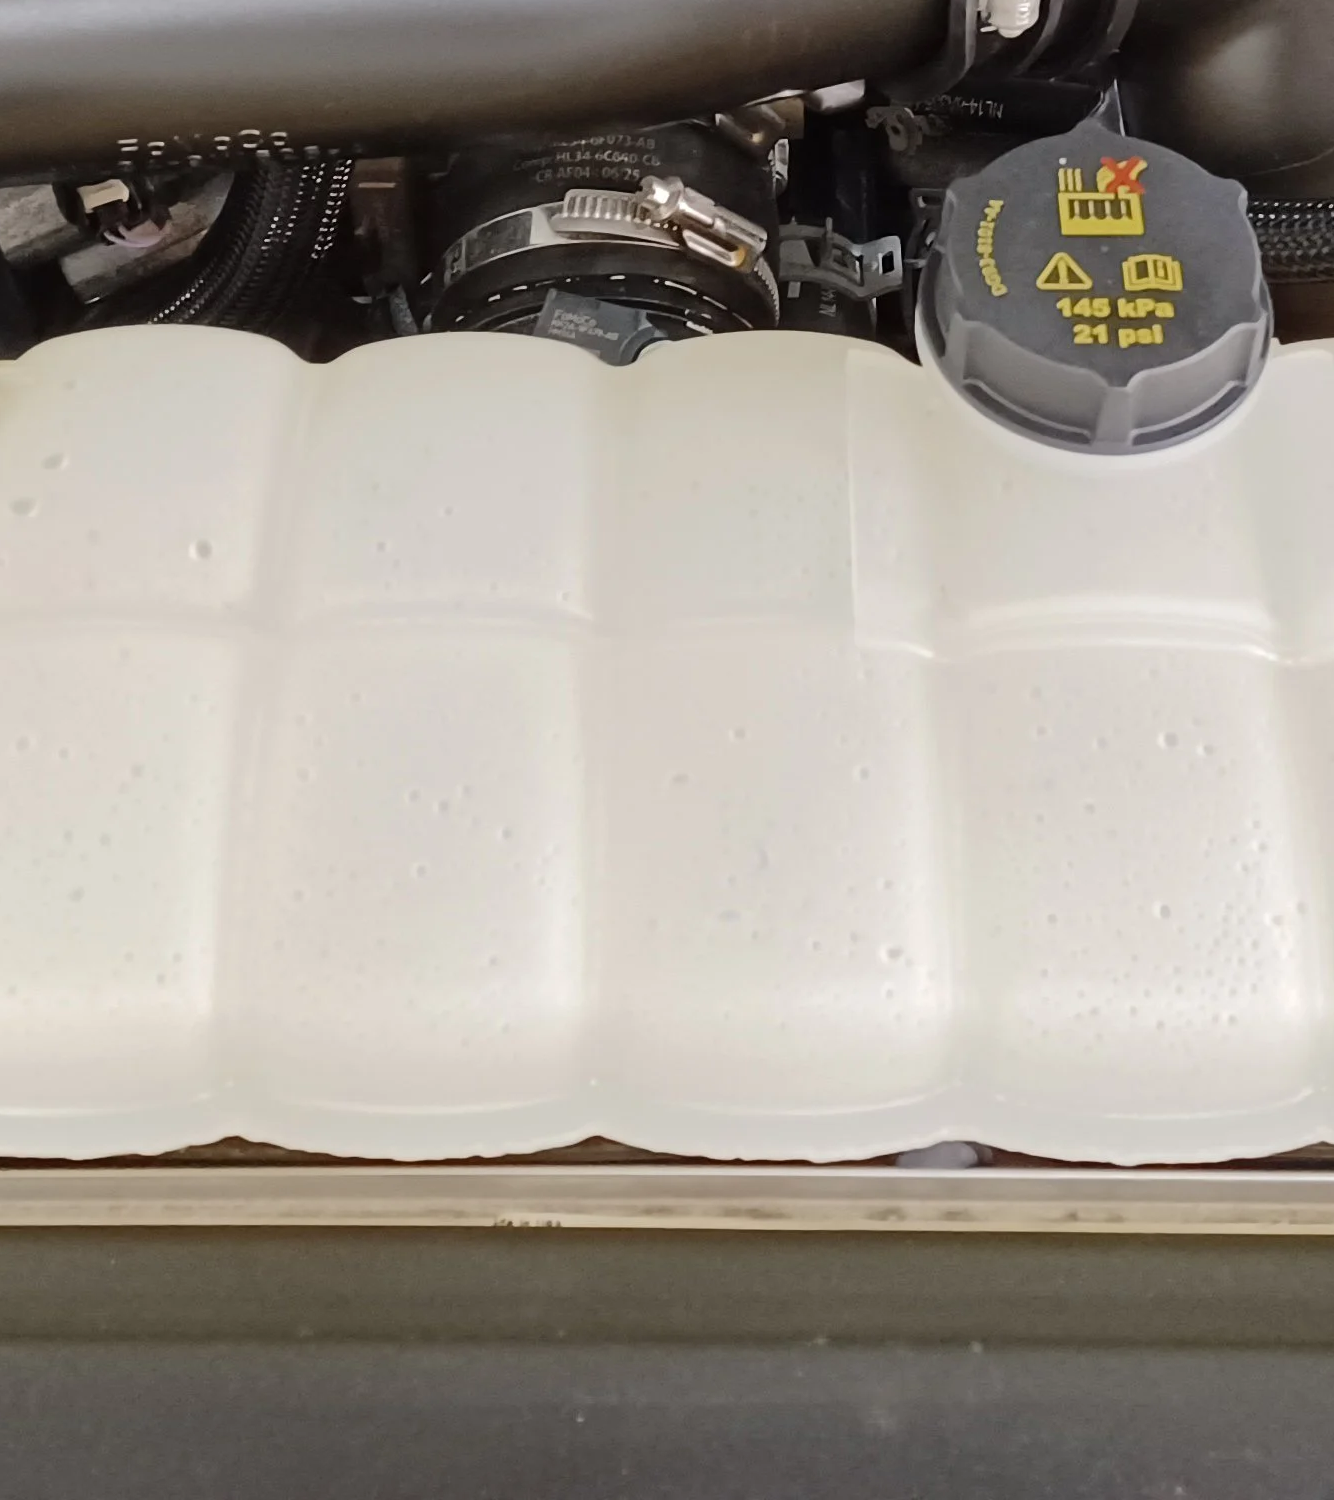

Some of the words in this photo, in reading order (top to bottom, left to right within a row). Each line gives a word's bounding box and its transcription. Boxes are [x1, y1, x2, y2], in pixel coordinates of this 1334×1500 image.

[1056, 297, 1111, 318] 145
[1117, 297, 1175, 318] kPa
[1073, 323, 1109, 345] 21
[1118, 323, 1164, 349] psi
